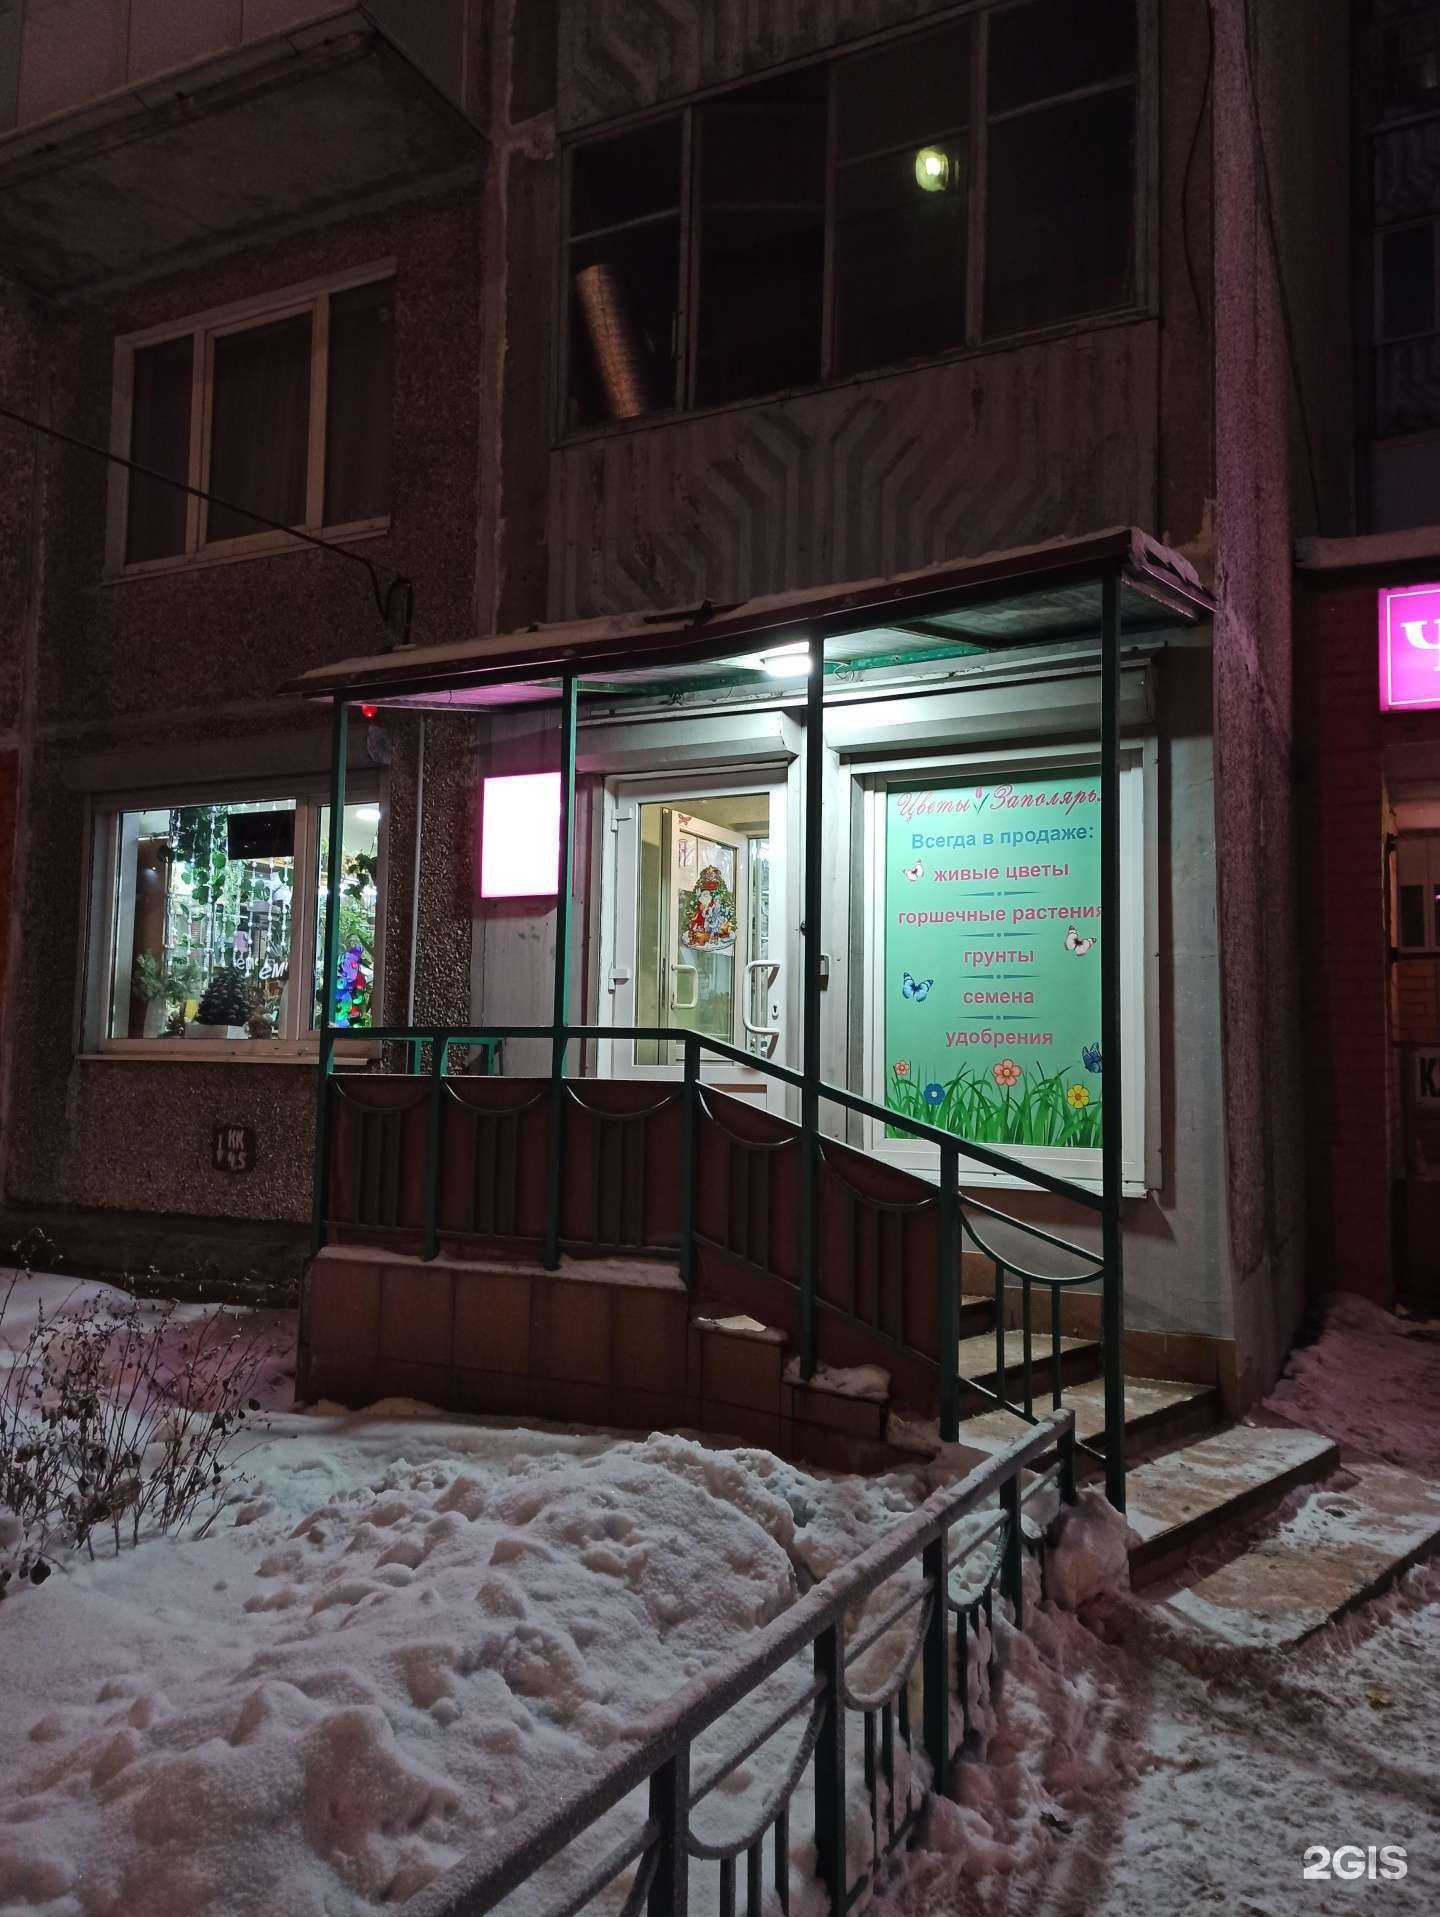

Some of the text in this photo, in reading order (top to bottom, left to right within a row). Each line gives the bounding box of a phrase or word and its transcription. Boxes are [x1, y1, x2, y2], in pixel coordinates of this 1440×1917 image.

[897, 791, 971, 823] Цветы
[989, 783, 1101, 815] Заполярь
[911, 824, 1094, 849] Всегда в продаже:
[933, 861, 1069, 882] живые цветы
[898, 907, 1006, 925] горшечные
[963, 948, 1034, 967] грунты
[963, 990, 1034, 1004] семена
[945, 1028, 1053, 1048] удобрения
